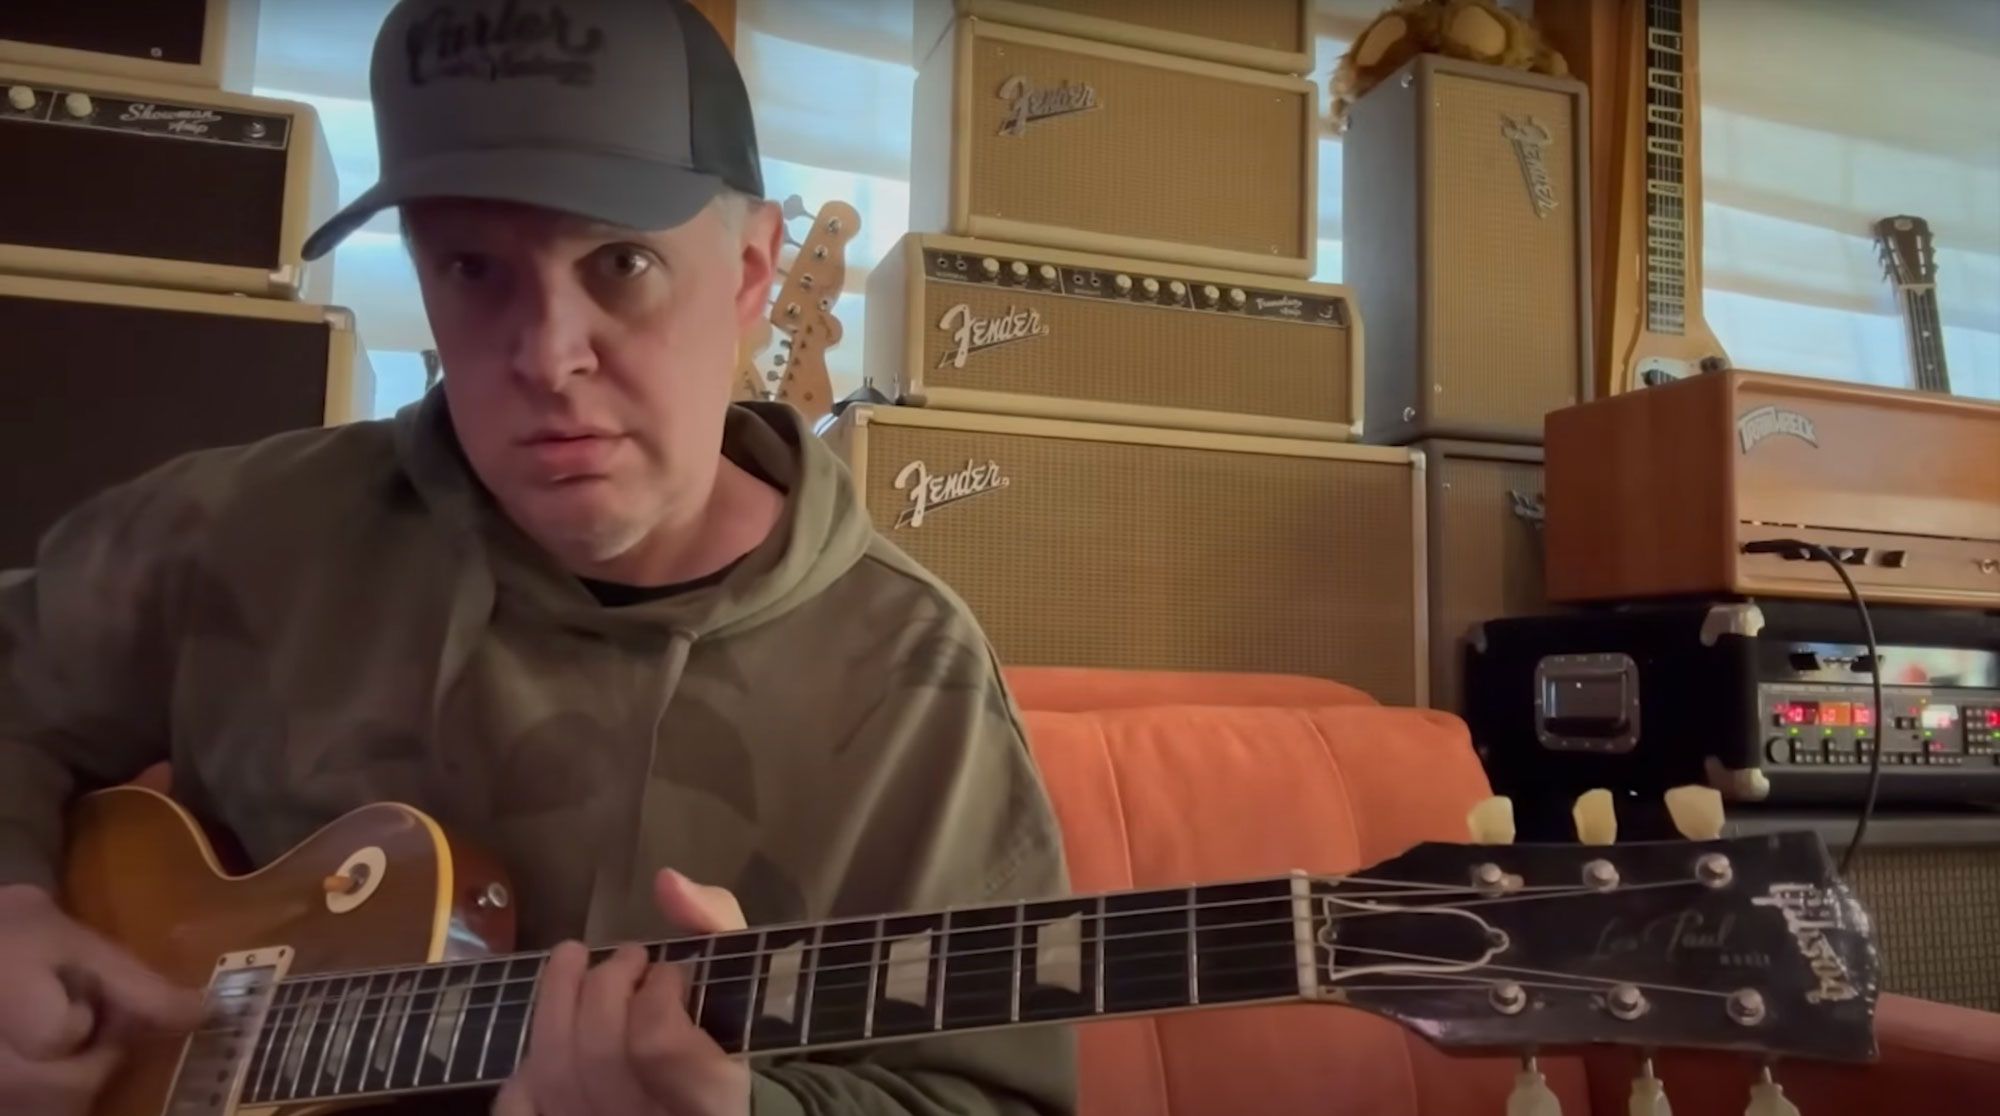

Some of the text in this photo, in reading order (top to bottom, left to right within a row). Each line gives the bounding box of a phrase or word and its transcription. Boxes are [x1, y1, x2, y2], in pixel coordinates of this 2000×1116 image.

[119, 103, 222, 122] Showman
[998, 75, 1102, 138] Fender
[1501, 117, 1559, 218] Fender
[938, 304, 1048, 369] Fender
[894, 458, 1009, 530] Fender
